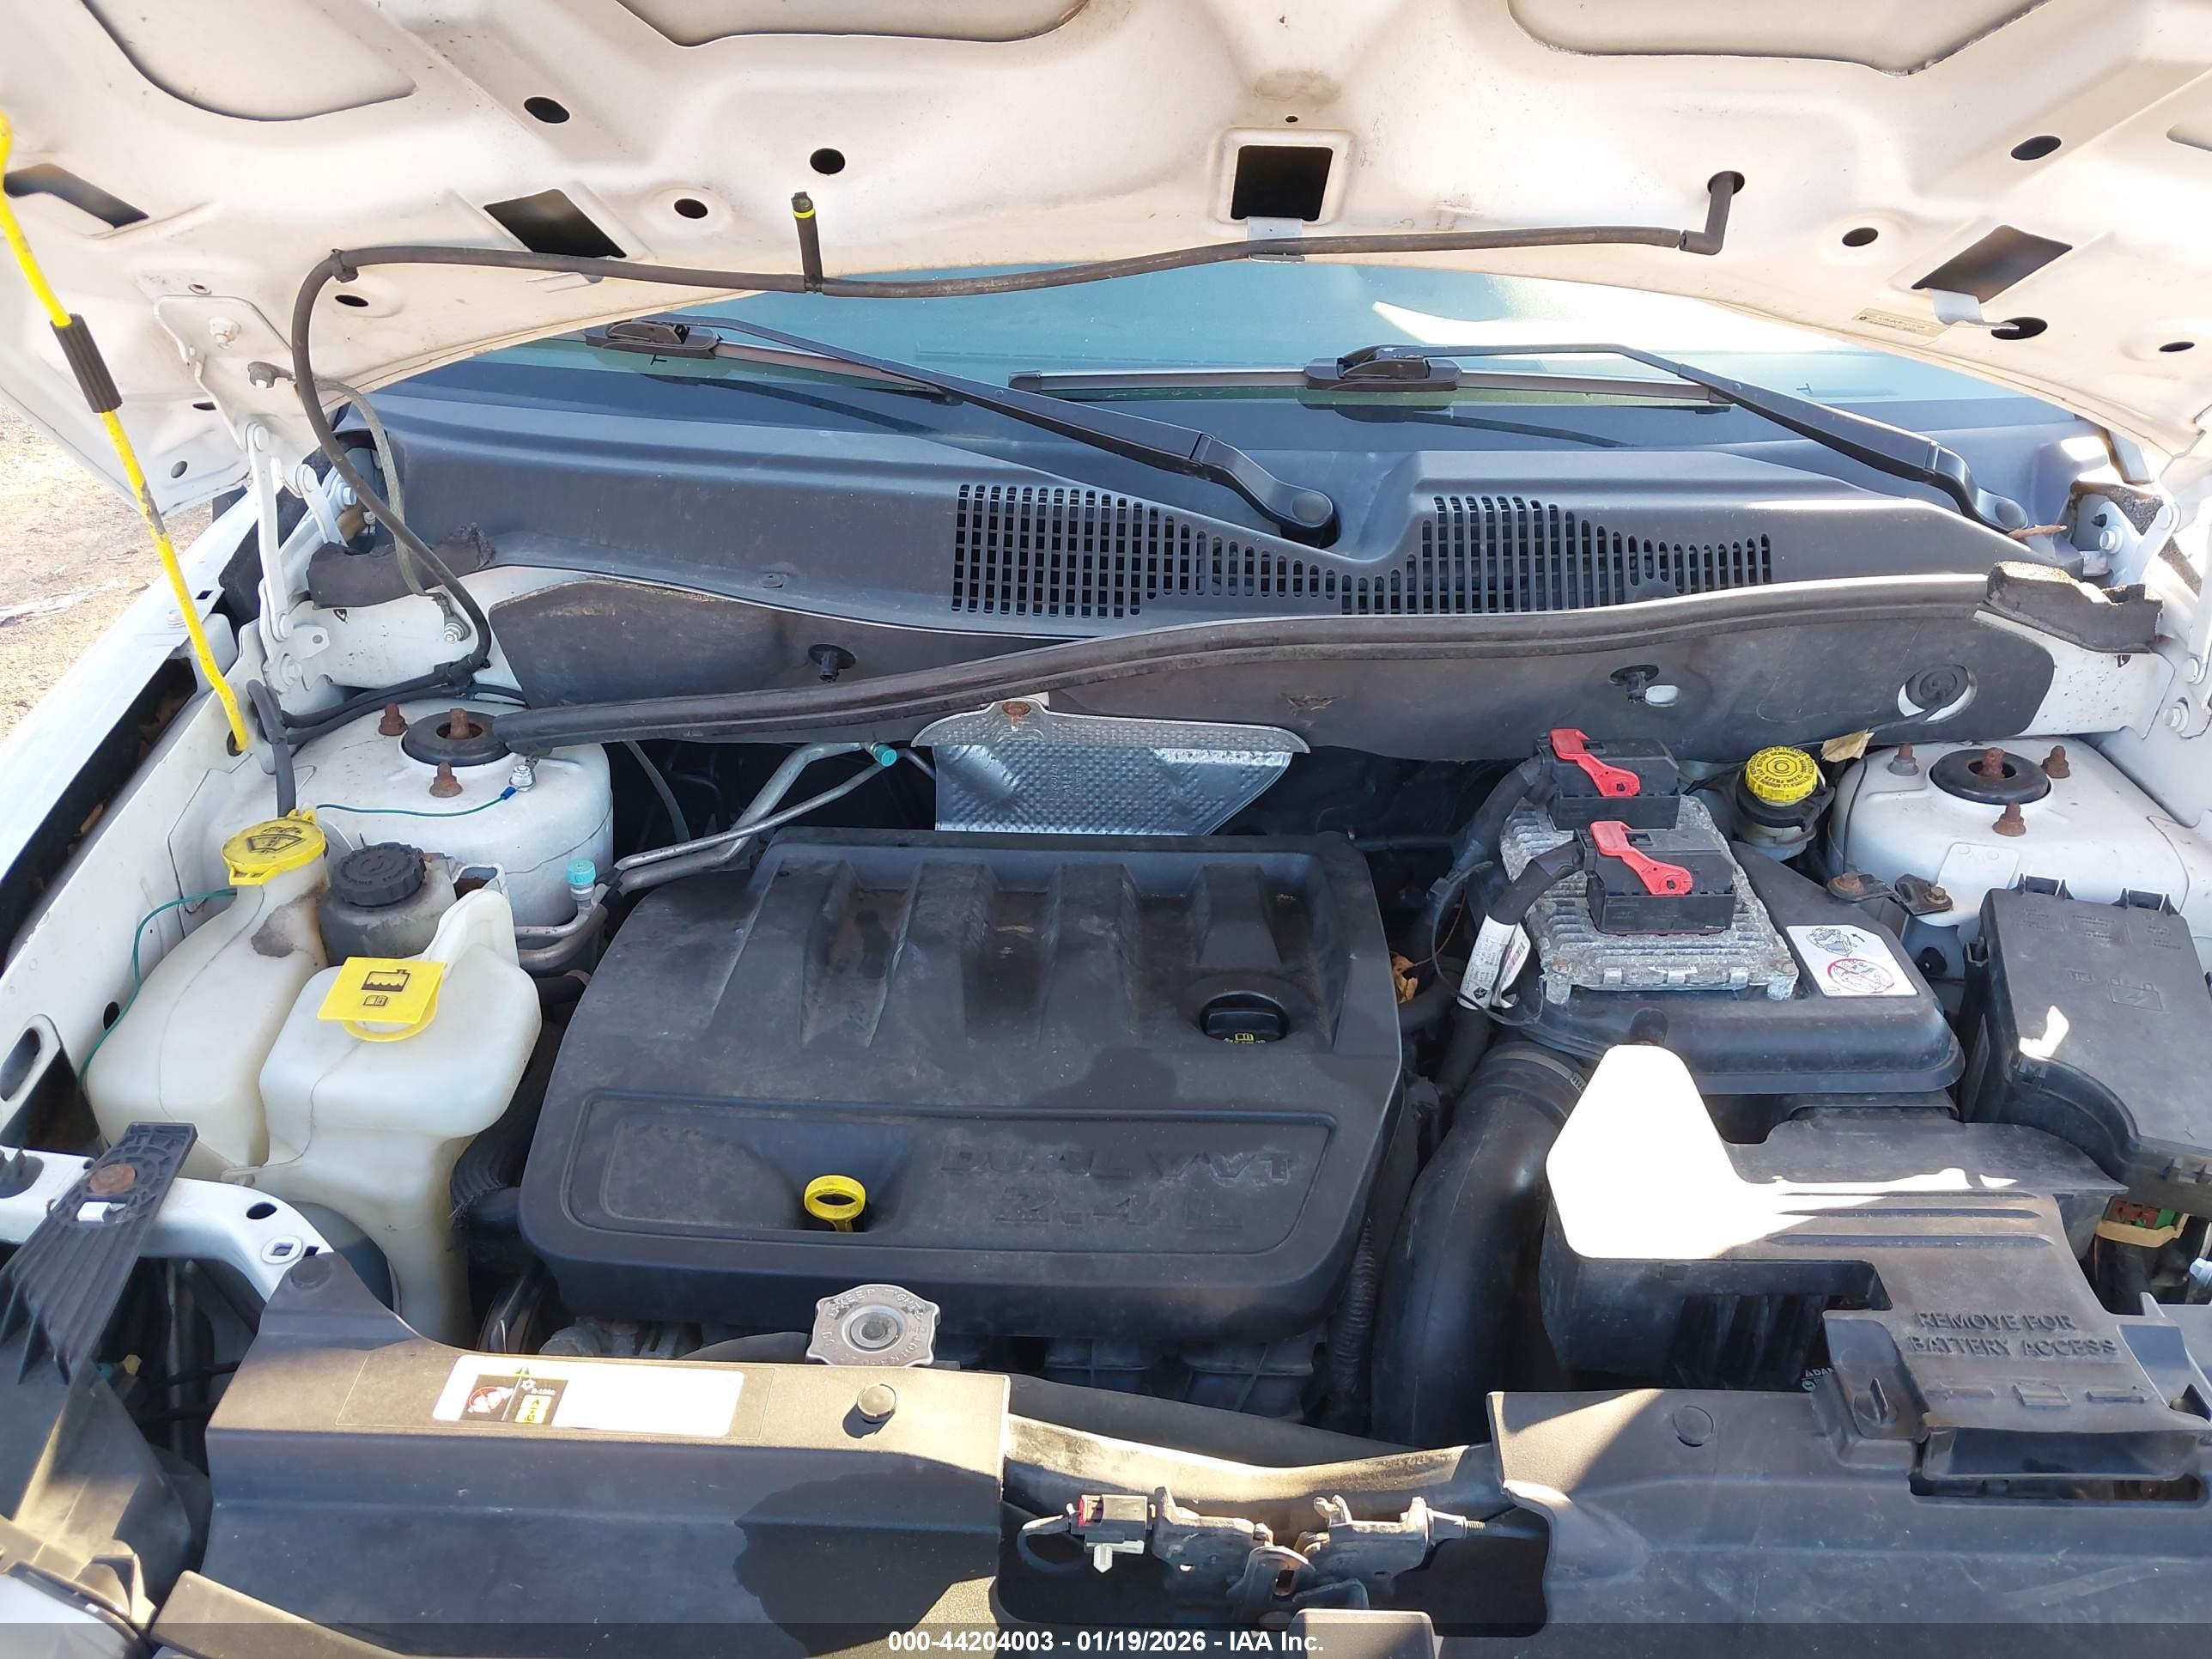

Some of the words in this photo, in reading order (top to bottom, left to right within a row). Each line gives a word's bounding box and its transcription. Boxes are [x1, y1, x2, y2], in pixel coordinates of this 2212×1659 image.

[1914, 1311, 2020, 1331] REMOVE
[2022, 1314, 2077, 1331] FOR
[1908, 1336, 2012, 1357] BATTERY
[2021, 1339, 2118, 1358] ACCESS
